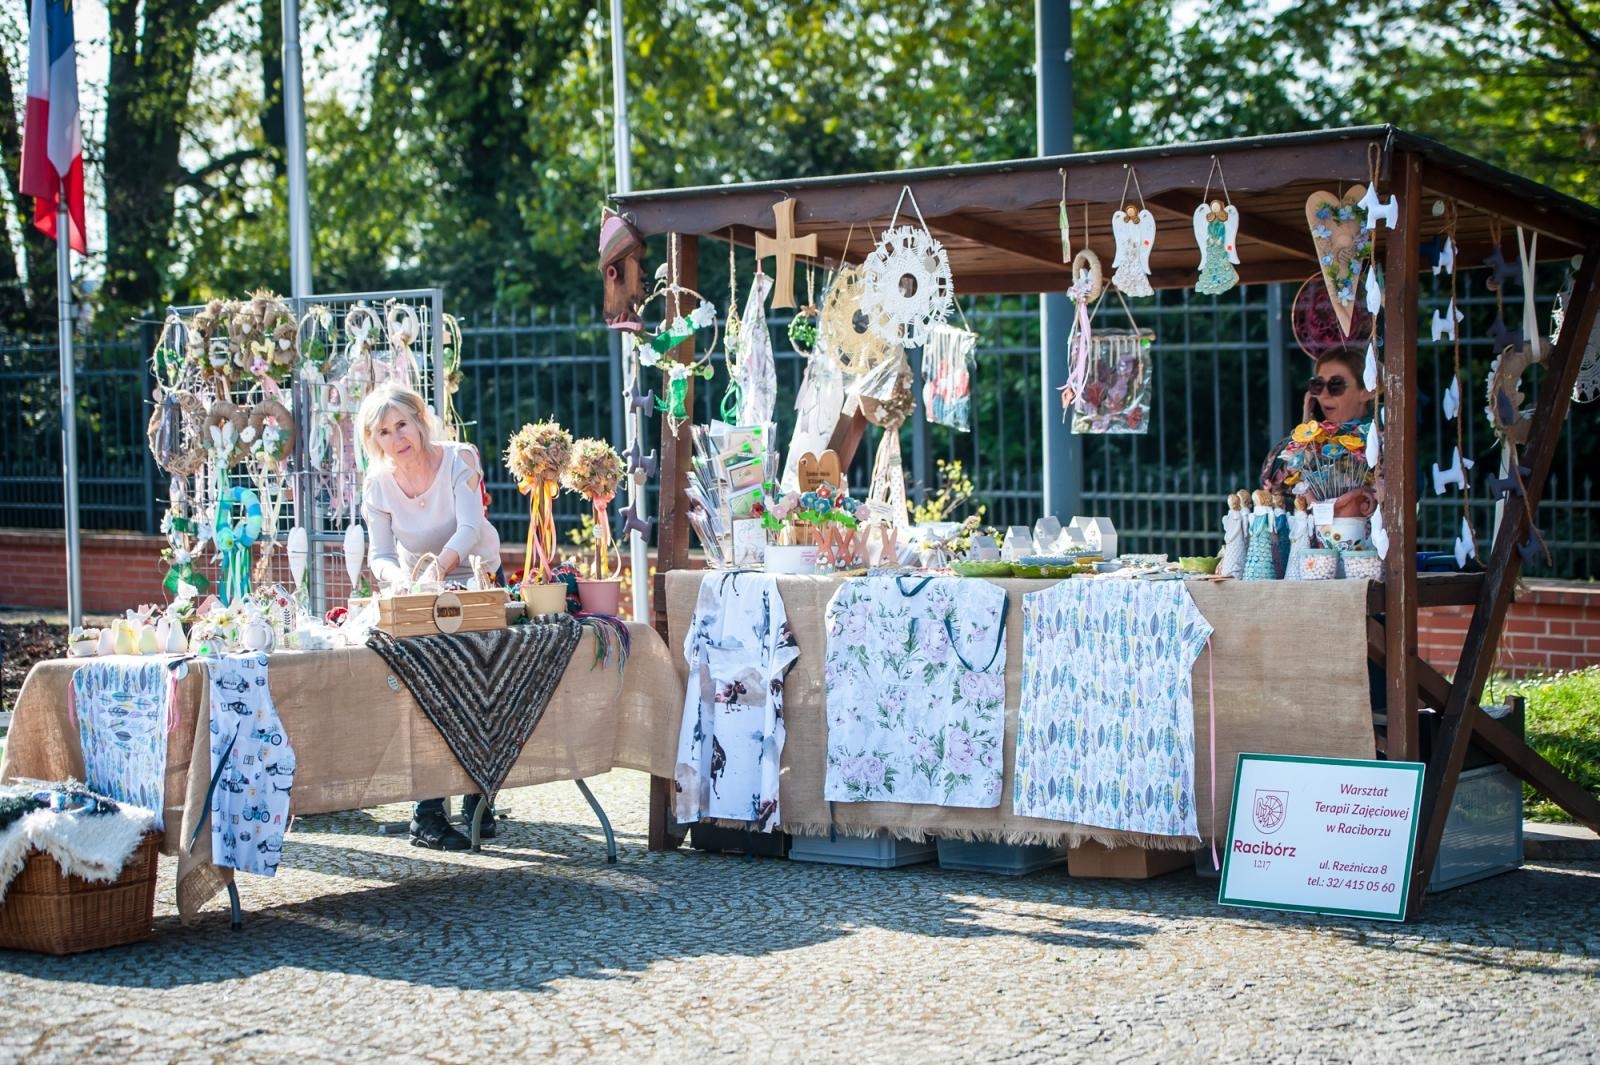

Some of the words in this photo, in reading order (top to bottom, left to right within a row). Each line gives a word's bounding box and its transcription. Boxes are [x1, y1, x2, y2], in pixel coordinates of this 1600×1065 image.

[1340, 784, 1388, 797] Warsztat
[1315, 802, 1350, 815] Terapii
[1352, 804, 1410, 820] Zajęciowej
[1338, 823, 1391, 837] Raciborzu
[1233, 840, 1296, 857] Racibórz
[1254, 860, 1271, 871] 1217
[1319, 860, 1330, 870] ul.
[1332, 861, 1378, 874] Rzeźnicza
[1380, 865, 1388, 874] 8
[1307, 876, 1325, 887] tel.:
[1345, 880, 1364, 890] 415
[1366, 882, 1380, 892] 05
[1382, 883, 1395, 892] 60
